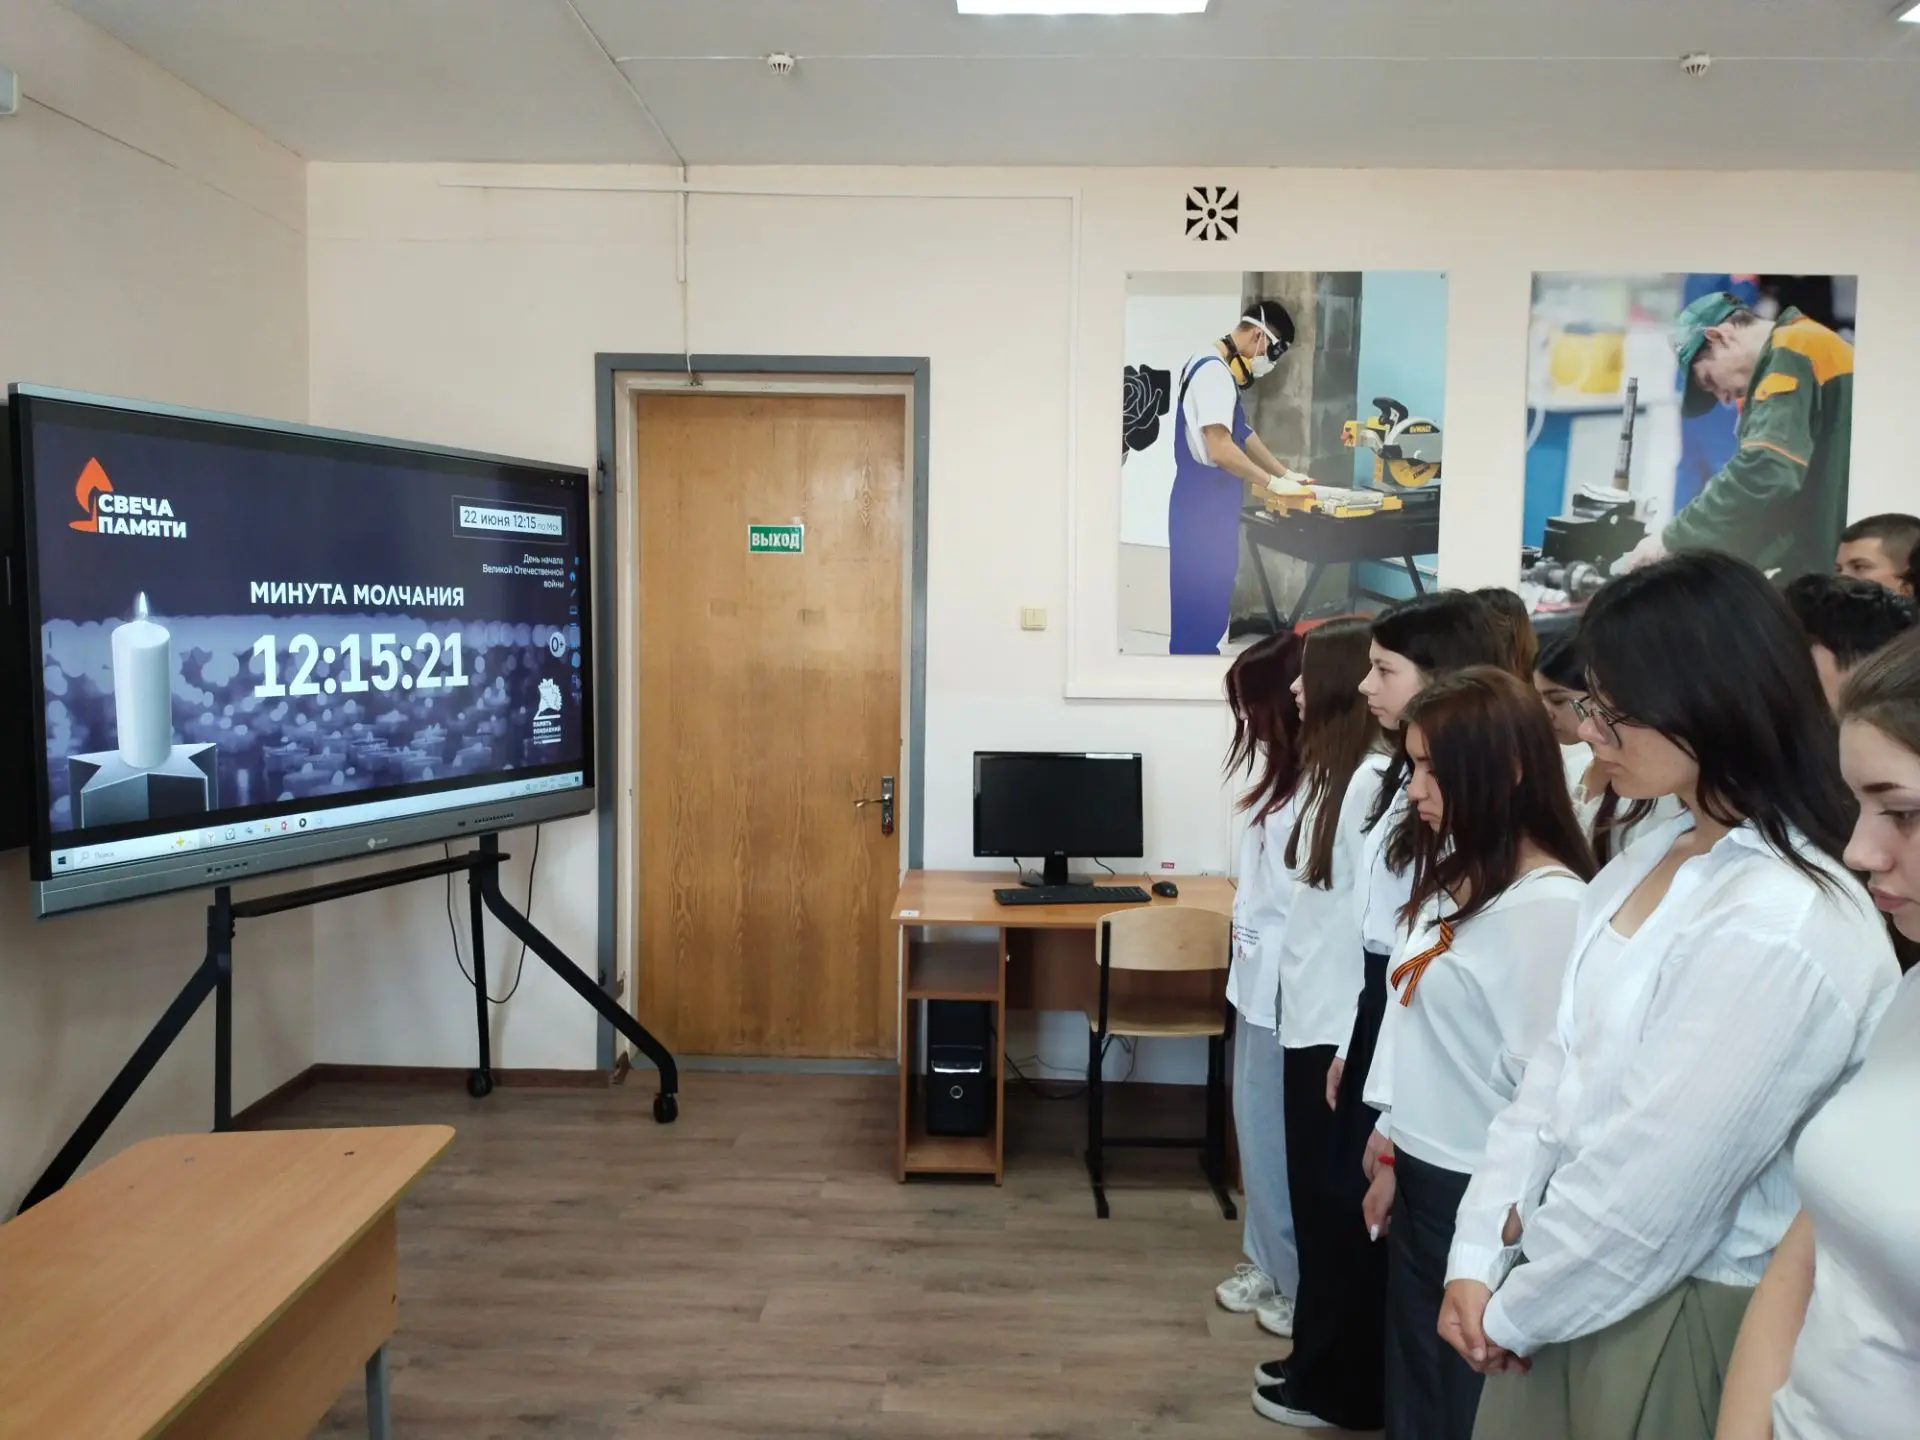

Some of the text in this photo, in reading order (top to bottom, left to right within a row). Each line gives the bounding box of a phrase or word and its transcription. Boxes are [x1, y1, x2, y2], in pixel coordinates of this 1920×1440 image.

[98, 493, 174, 517] СВЕЧА
[98, 516, 187, 538] ПАМЯТИ
[464, 510, 477, 524] 22
[481, 514, 510, 528] июня
[513, 515, 537, 530] 12:15
[752, 533, 800, 549] ВЫХОД
[523, 554, 564, 565] День начала
[482, 564, 564, 576] Великой Отечественной
[250, 581, 465, 607] МИНУТА МОЛЧАНИЯ
[551, 636, 564, 652] 0+
[253, 632, 469, 698] 12:15:21
